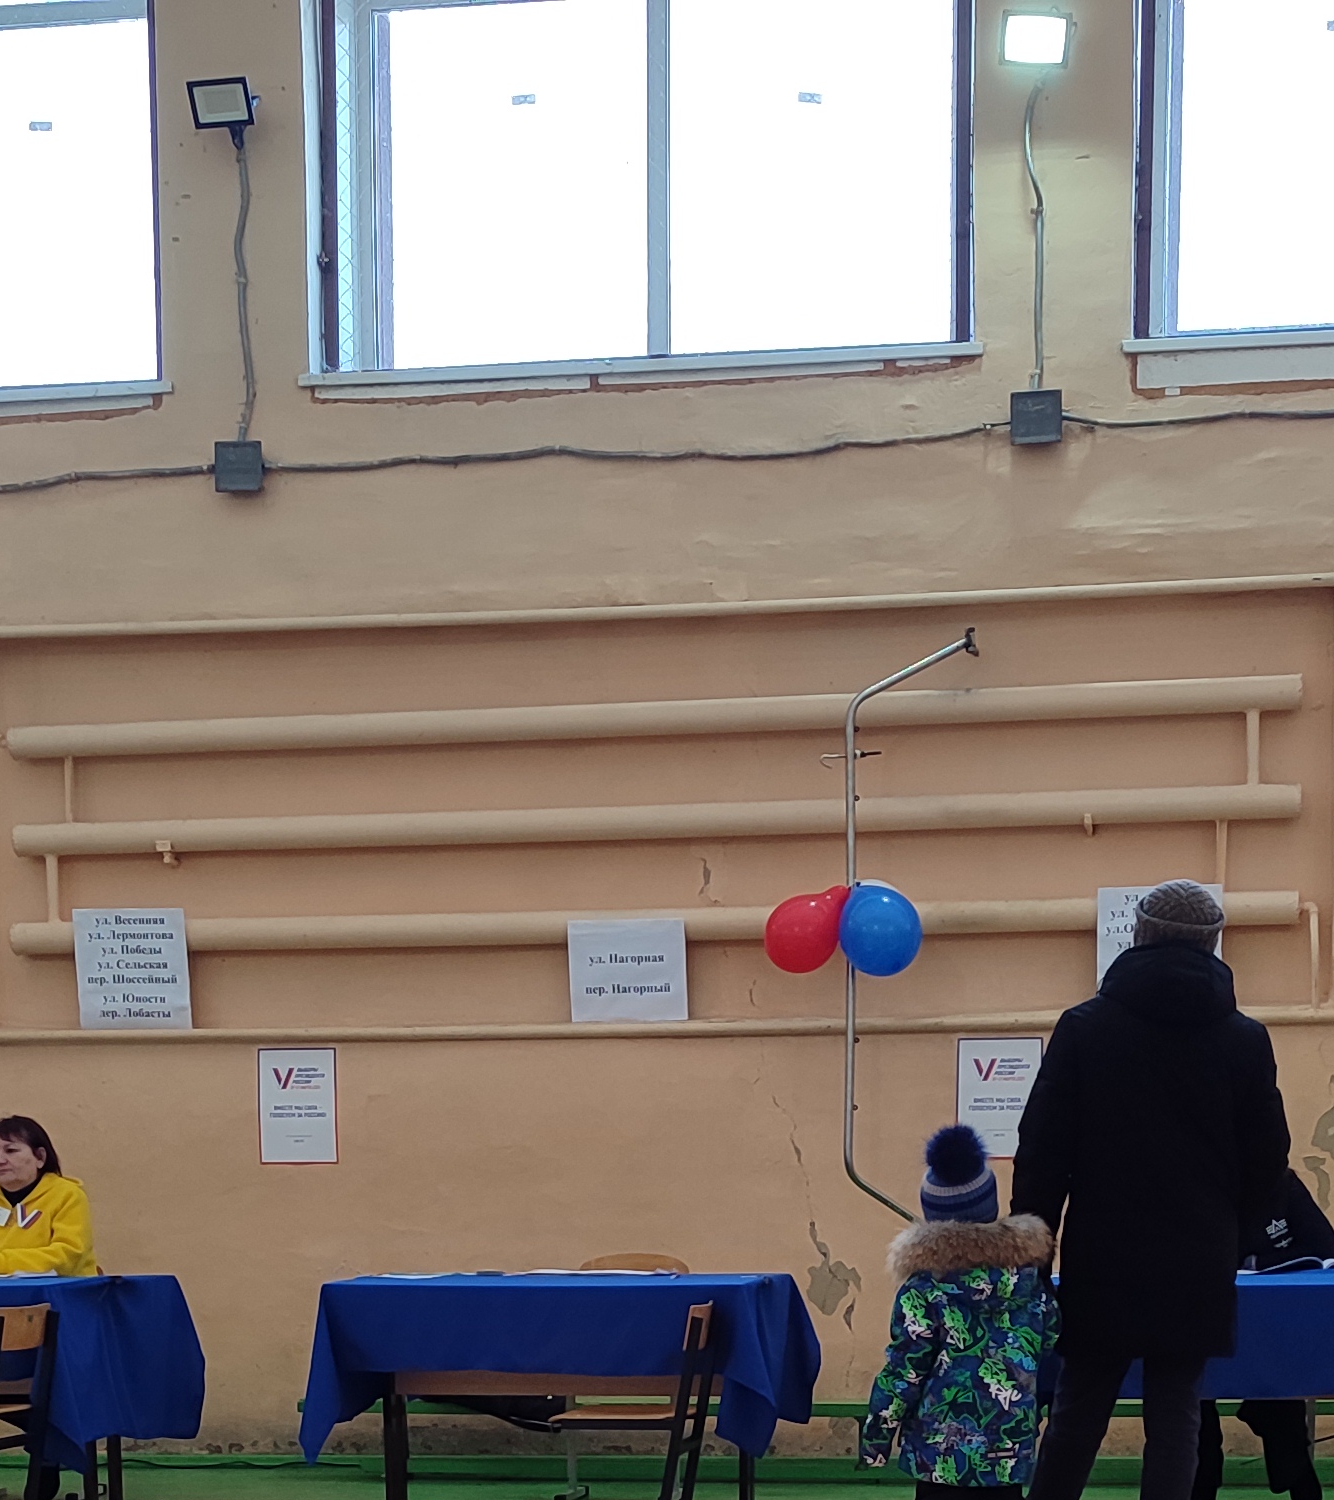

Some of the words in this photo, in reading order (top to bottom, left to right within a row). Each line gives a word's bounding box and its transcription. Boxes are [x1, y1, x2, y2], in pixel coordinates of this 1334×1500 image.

[95, 917, 111, 928] ул.
[114, 915, 165, 925] Весенняя
[88, 933, 104, 942] ул.
[107, 930, 174, 942] Лермонтова
[101, 947, 117, 957] ул.
[121, 945, 162, 955] Победы
[97, 961, 113, 971] ул.
[116, 959, 168, 969] Сельская
[589, 956, 606, 966] ул.
[609, 953, 665, 966] Нагорная
[87, 976, 109, 986] пер.
[112, 974, 177, 984] Шоссейный
[585, 986, 608, 997] пер.
[611, 983, 671, 996] Нагорный
[103, 995, 118, 1005] ул.
[122, 993, 166, 1003] Юности
[99, 1010, 121, 1019] дер.
